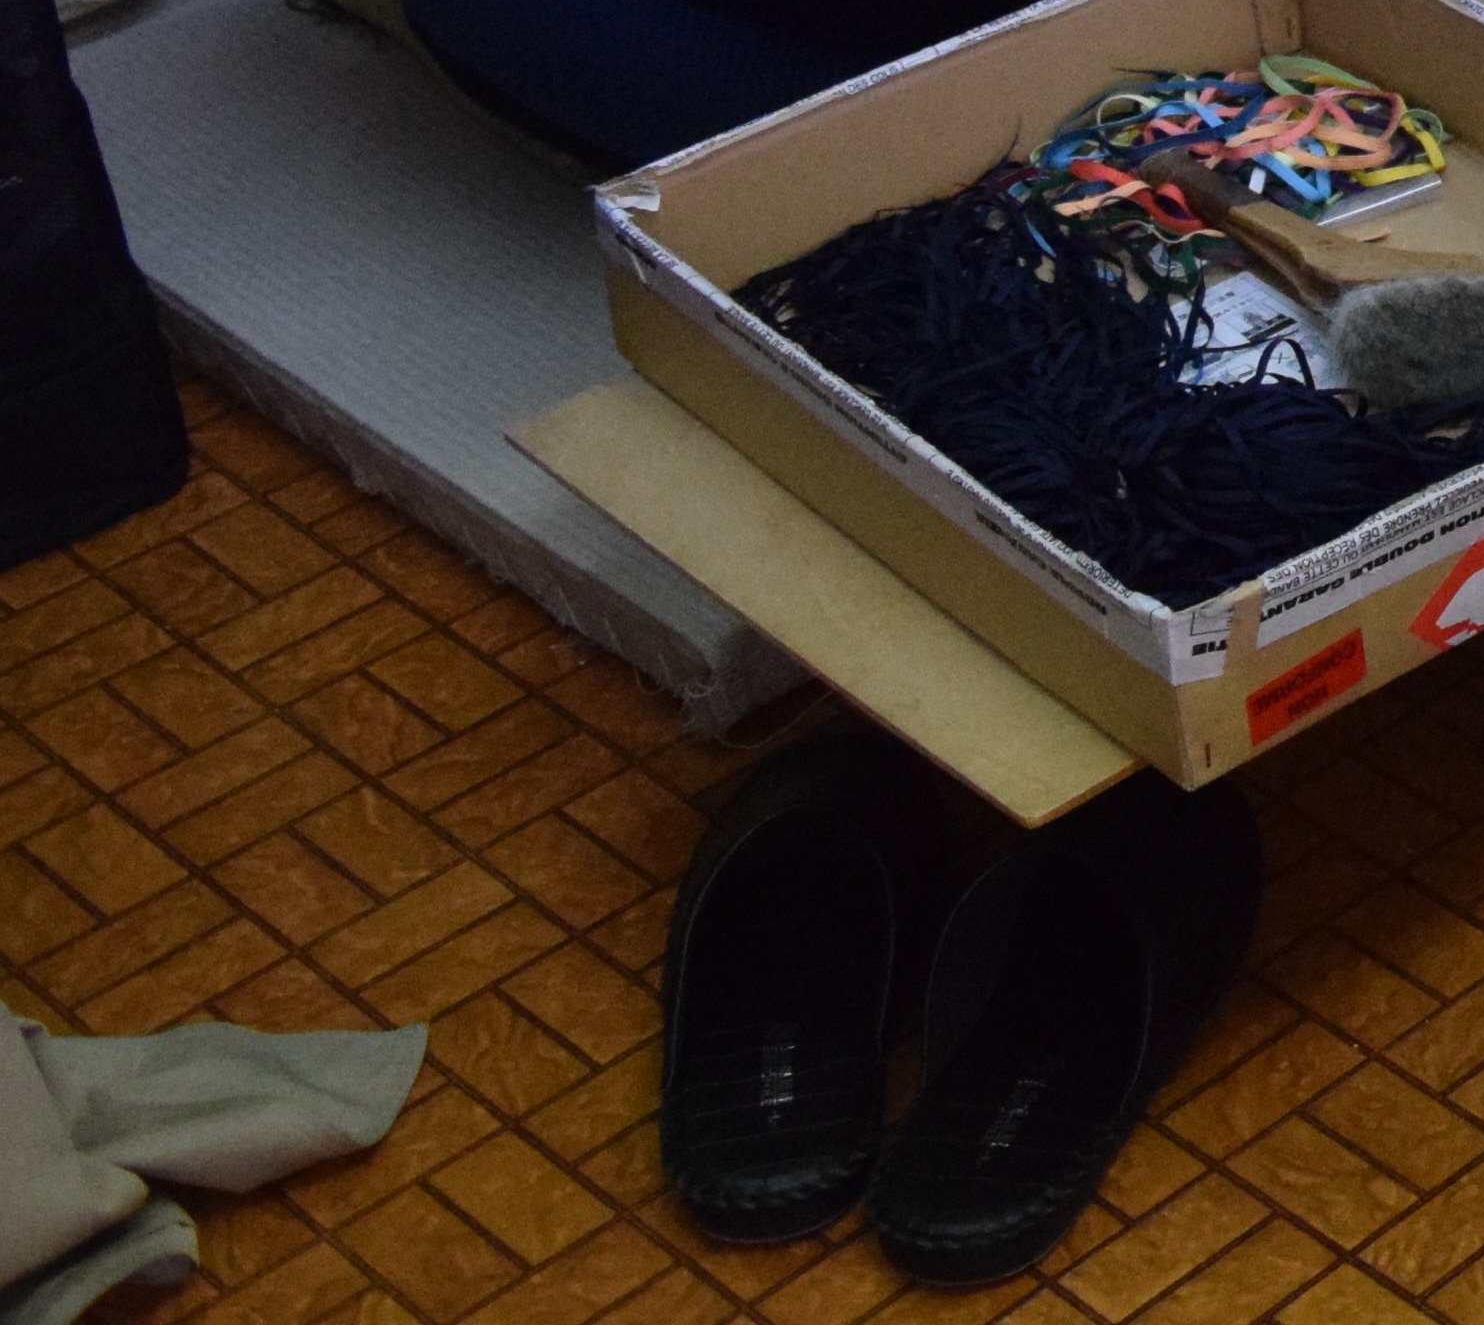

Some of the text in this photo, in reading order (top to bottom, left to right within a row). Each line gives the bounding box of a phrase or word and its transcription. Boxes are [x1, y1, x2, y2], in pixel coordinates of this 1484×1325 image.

[1347, 529, 1436, 581] DOUBLE
[1301, 558, 1341, 581] CETTE
[1262, 575, 1301, 598] BAND
